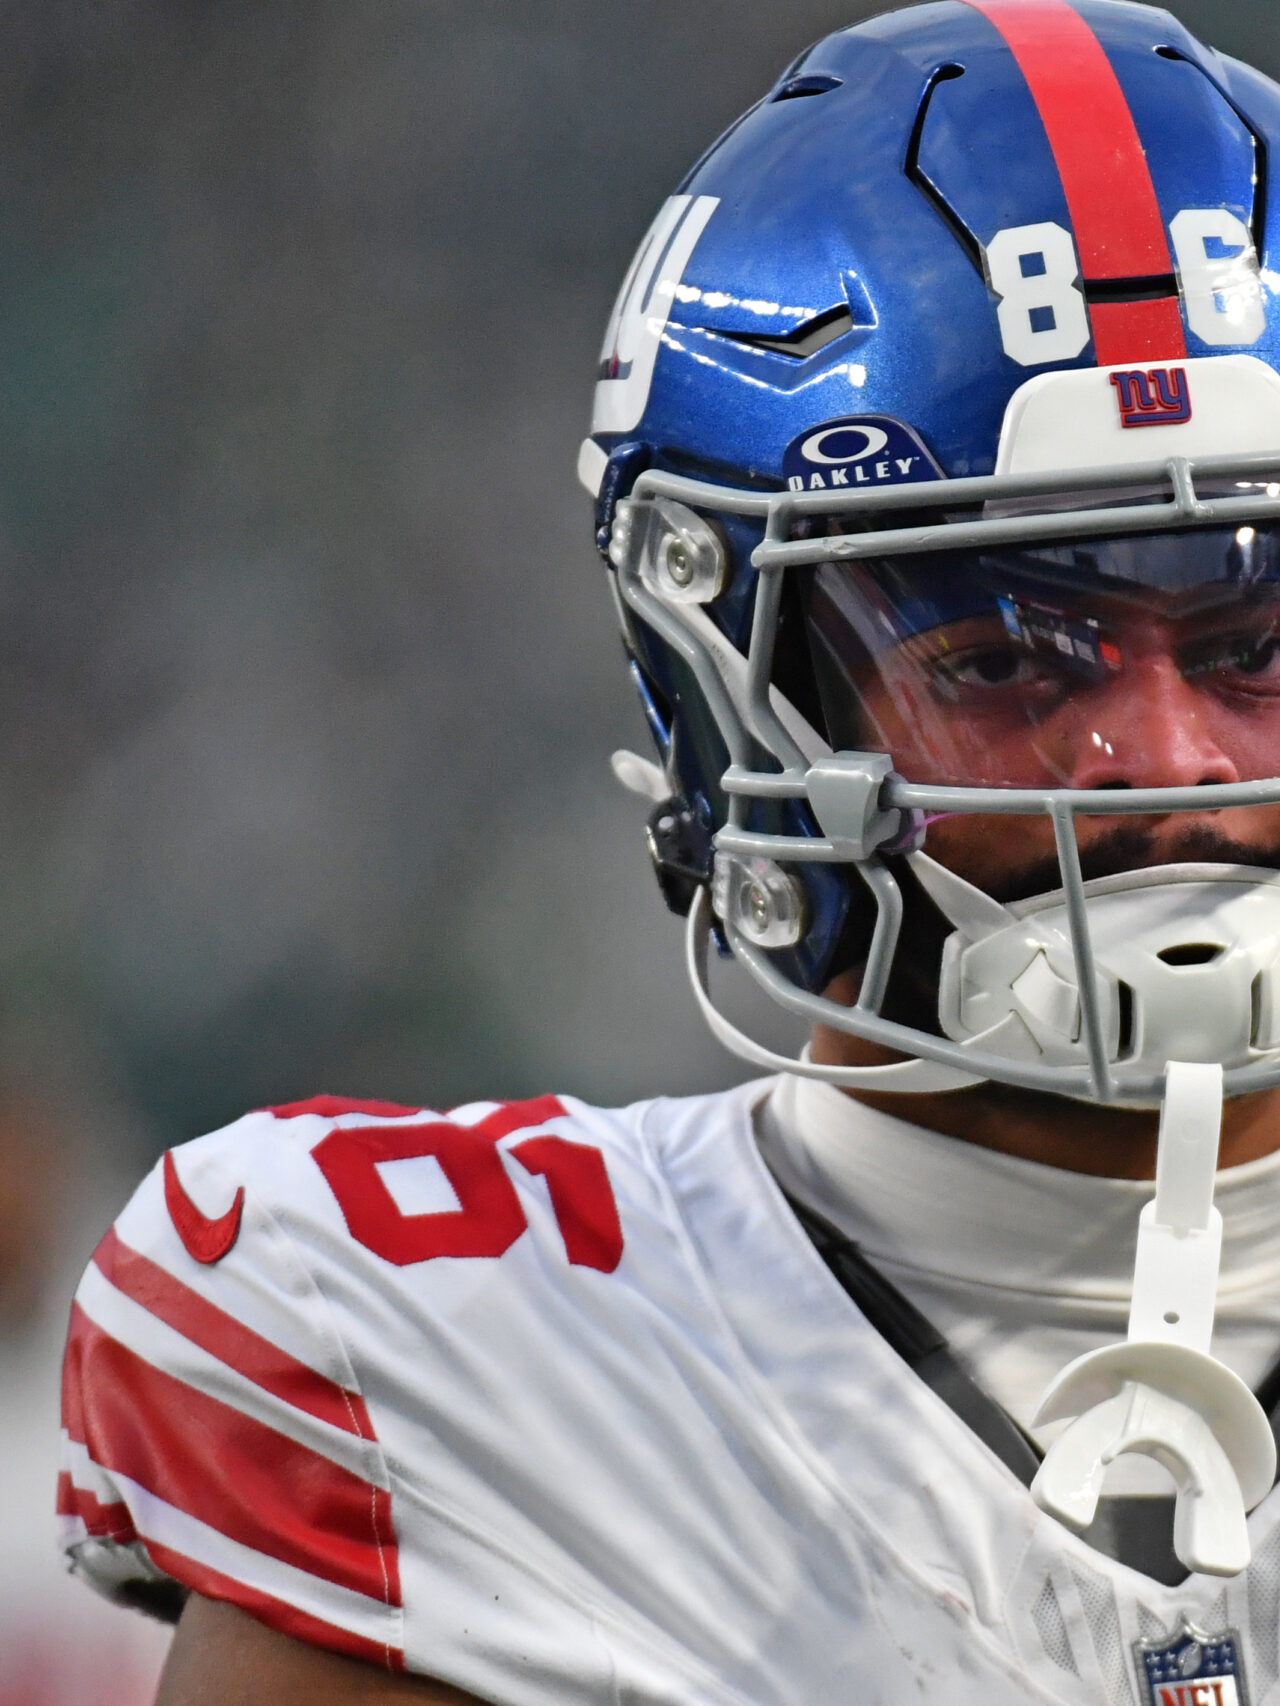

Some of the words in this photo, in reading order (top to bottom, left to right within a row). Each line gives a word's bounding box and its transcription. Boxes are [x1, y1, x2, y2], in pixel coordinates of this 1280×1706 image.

[986, 221, 1090, 366] 8
[1169, 209, 1266, 345] 6
[788, 457, 912, 492] OAKLEY
[254, 1094, 624, 1274] 6
